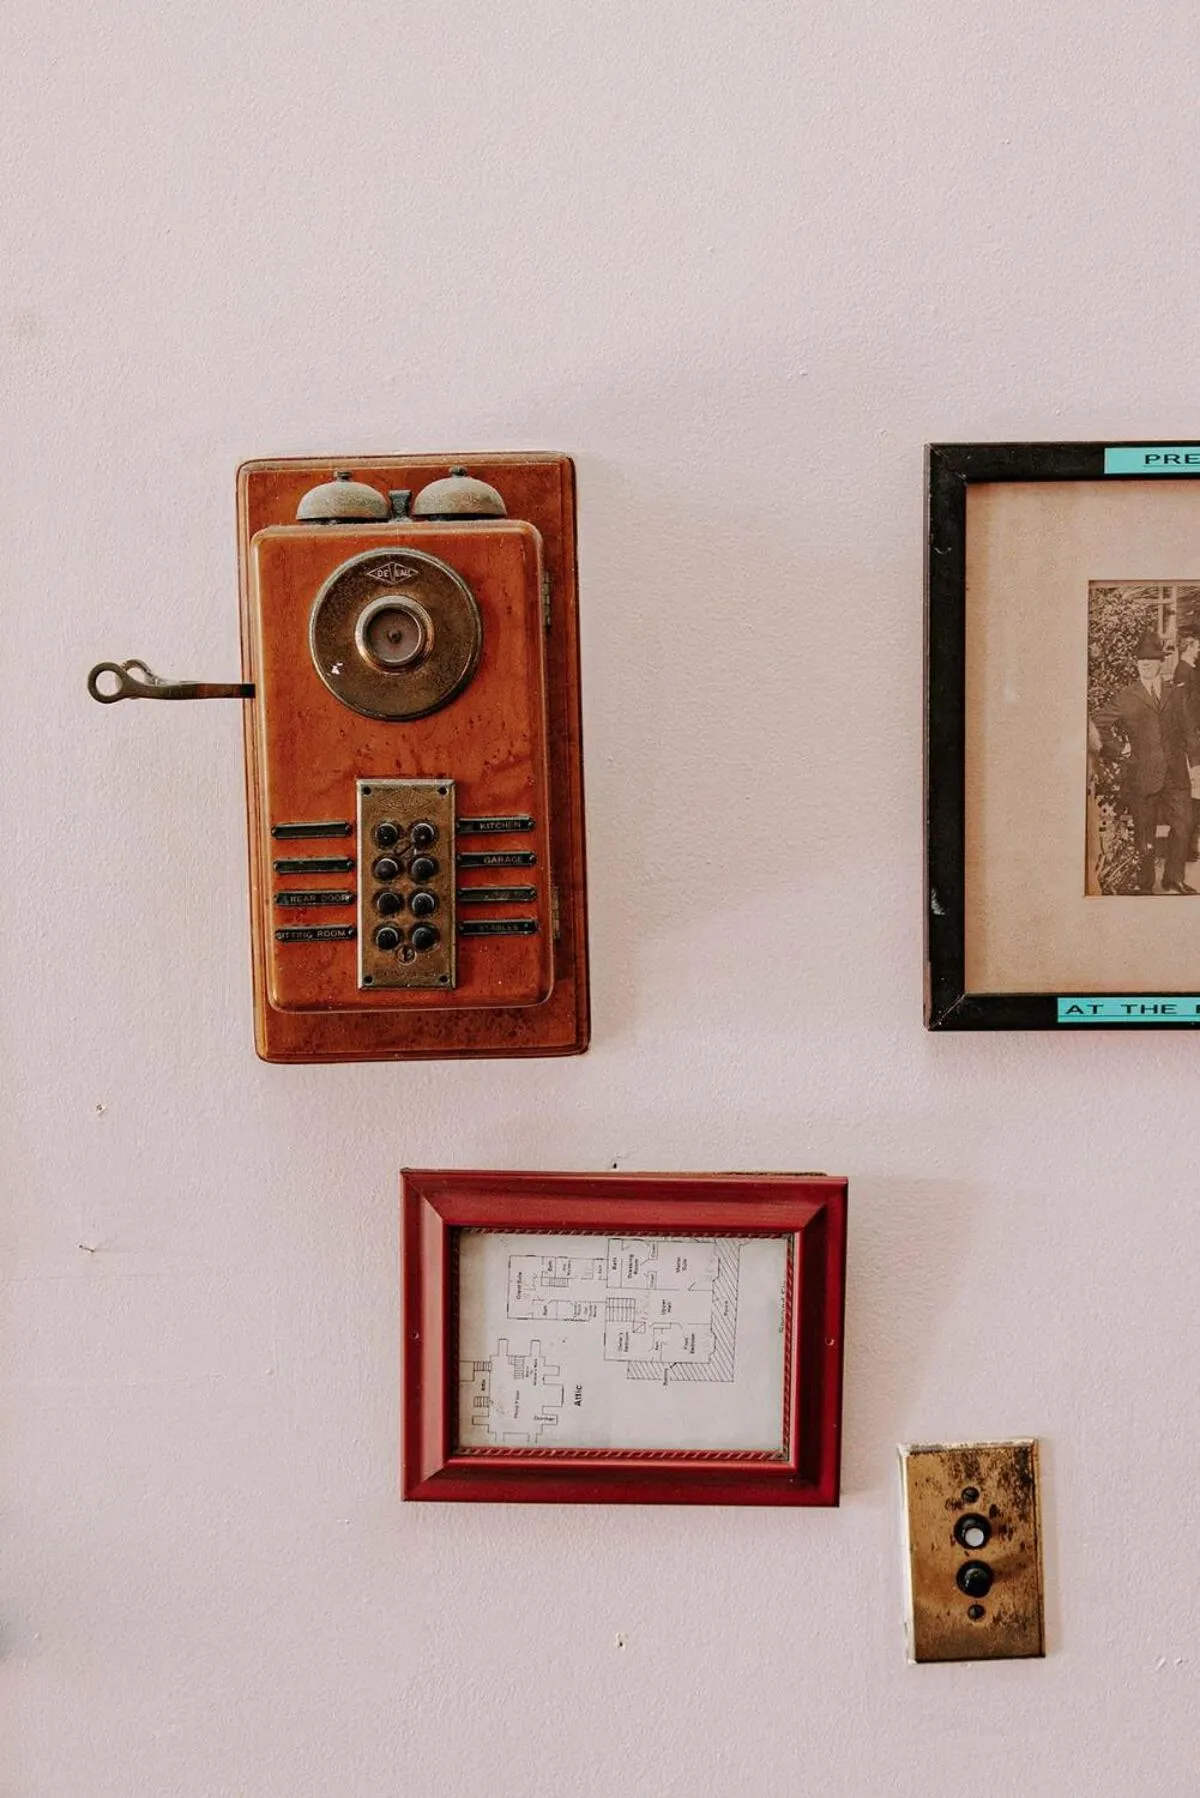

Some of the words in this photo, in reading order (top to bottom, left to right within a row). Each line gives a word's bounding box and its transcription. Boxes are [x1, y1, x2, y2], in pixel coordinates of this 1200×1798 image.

[1144, 453, 1200, 465] PRE
[480, 820, 521, 831] KITCHEN
[483, 855, 522, 865] GARAGE
[290, 895, 317, 903] REAR
[316, 927, 346, 937] ROOM
[1066, 1004, 1104, 1015] AT
[1121, 1004, 1178, 1015] THE
[573, 1384, 583, 1407] Attic
